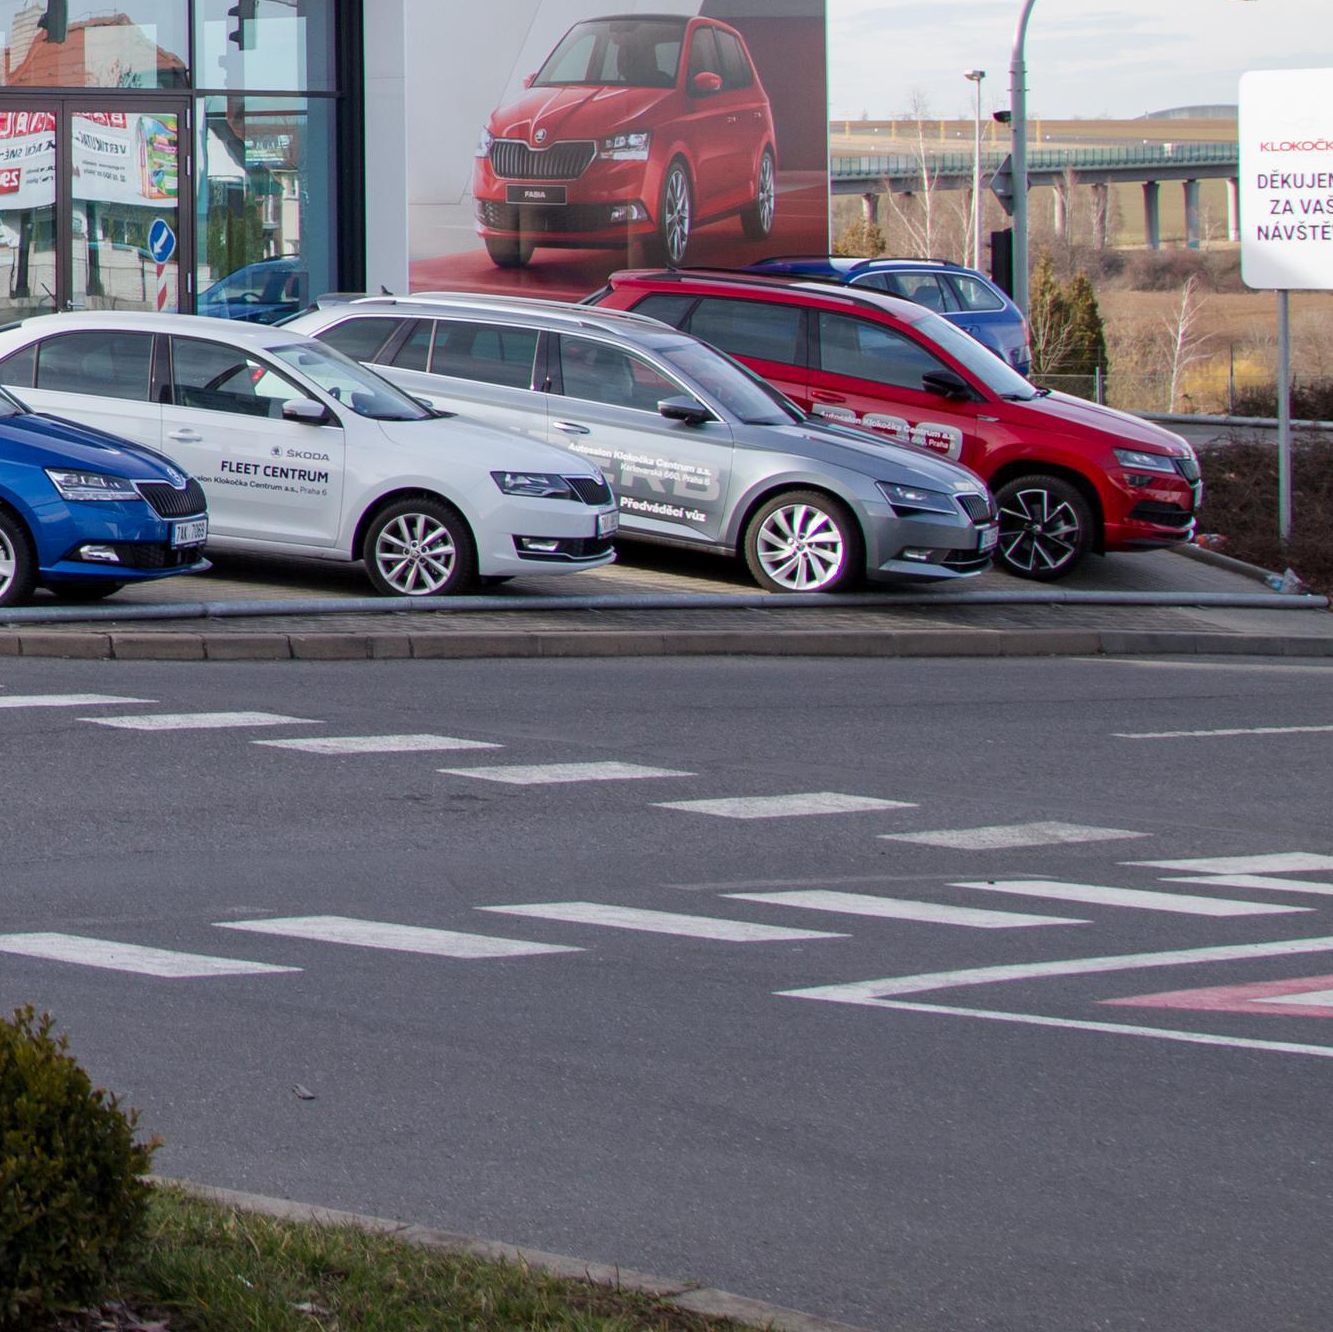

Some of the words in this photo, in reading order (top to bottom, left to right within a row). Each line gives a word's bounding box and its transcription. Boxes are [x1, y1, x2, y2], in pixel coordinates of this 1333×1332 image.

[1270, 199, 1294, 214] ZA
[1257, 221, 1333, 241] NÁVŠTĚ
[863, 419, 902, 432] Klokočka
[903, 423, 940, 439] Centrum
[928, 438, 949, 449] Praha
[286, 448, 330, 461] ŠKODA
[568, 442, 612, 458] Autosalon
[613, 450, 655, 466] Klokočka
[656, 458, 695, 473] Centrum
[220, 460, 260, 475] FLEET
[263, 465, 329, 483] CENTRUM
[683, 474, 703, 486] Praha
[213, 476, 248, 487] Klokočka
[249, 480, 283, 491] Centrum
[299, 486, 321, 496] Praha
[620, 496, 683, 518] Předváděcí
[685, 509, 707, 522] vůz
